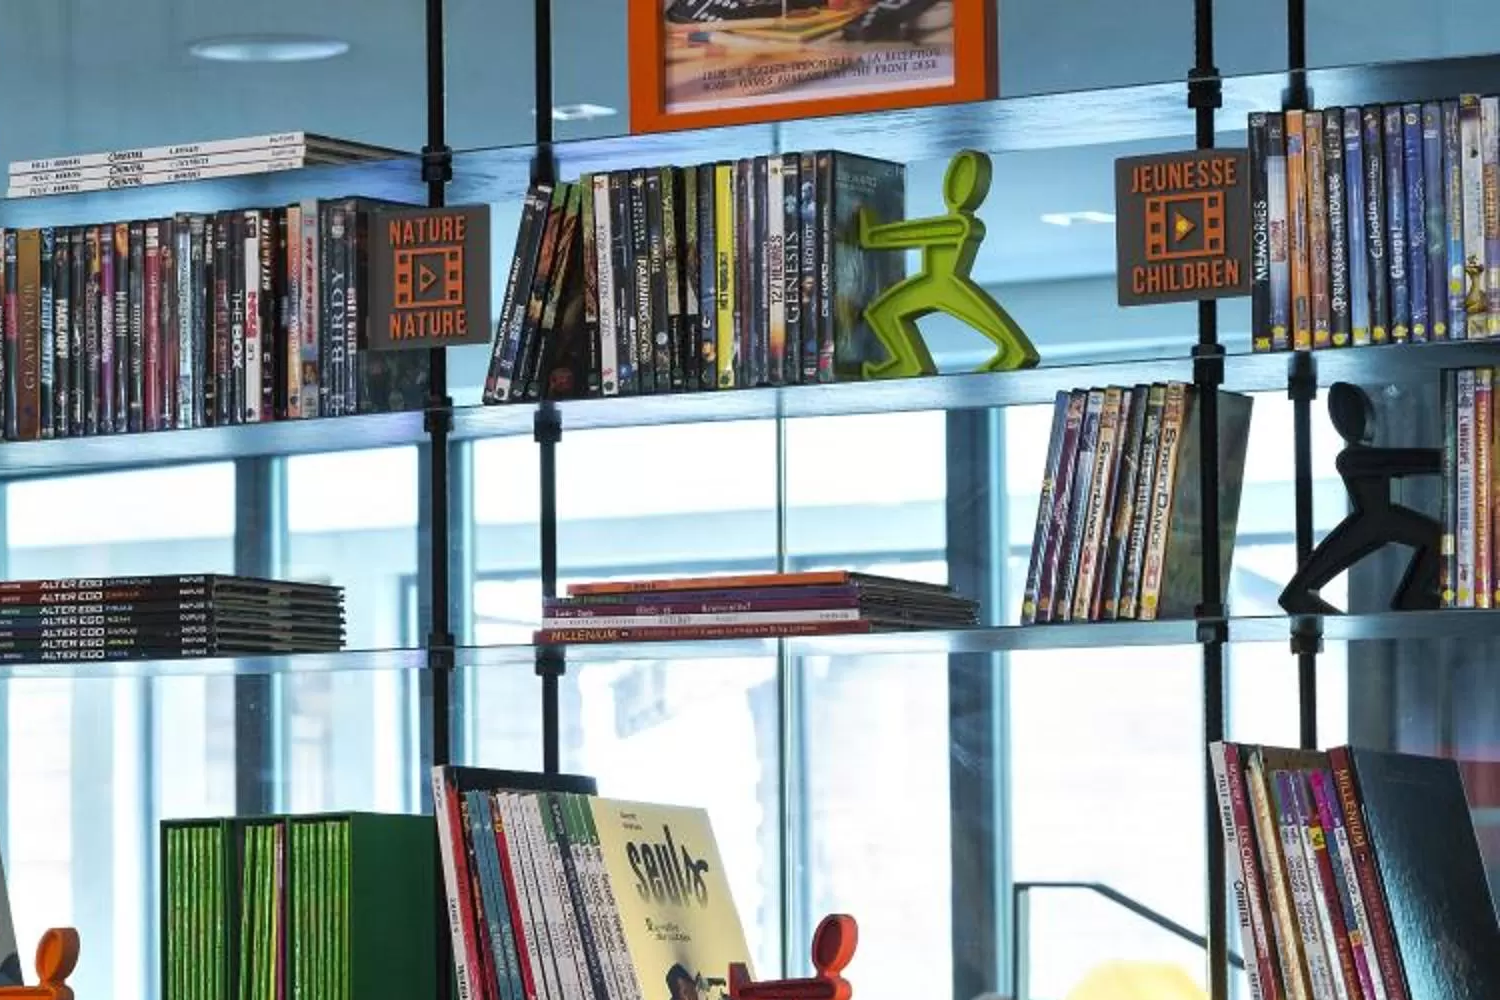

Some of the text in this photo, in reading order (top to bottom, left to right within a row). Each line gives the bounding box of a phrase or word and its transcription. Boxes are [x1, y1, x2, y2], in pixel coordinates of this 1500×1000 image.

[875, 60, 909, 75] FRONT
[1131, 157, 1238, 194] JEUNESSE
[389, 215, 466, 245] NATURE
[1252, 199, 1269, 280] MEMORIES
[786, 230, 799, 322] GENESIS
[1133, 258, 1240, 294] CHILDREN
[231, 289, 242, 368] THE BOX
[330, 268, 346, 363] BIRDY
[389, 309, 468, 339] NATURE
[24, 283, 38, 392] GLADIATOR
[39, 592, 77, 603] ALTER
[79, 591, 104, 601] EGO
[40, 580, 77, 590] ALTER
[79, 578, 104, 589] EGO
[39, 605, 76, 615] ALTER
[79, 603, 104, 614] EGO
[41, 616, 78, 627] ALTER
[80, 615, 105, 626] EGO
[41, 628, 79, 638] ALTER
[80, 626, 106, 638] EGO
[41, 639, 79, 650] ALTER
[80, 638, 105, 649] EGO
[41, 651, 79, 661] ALTER
[80, 649, 105, 660] EGO
[1335, 767, 1367, 847] MILLENIUM
